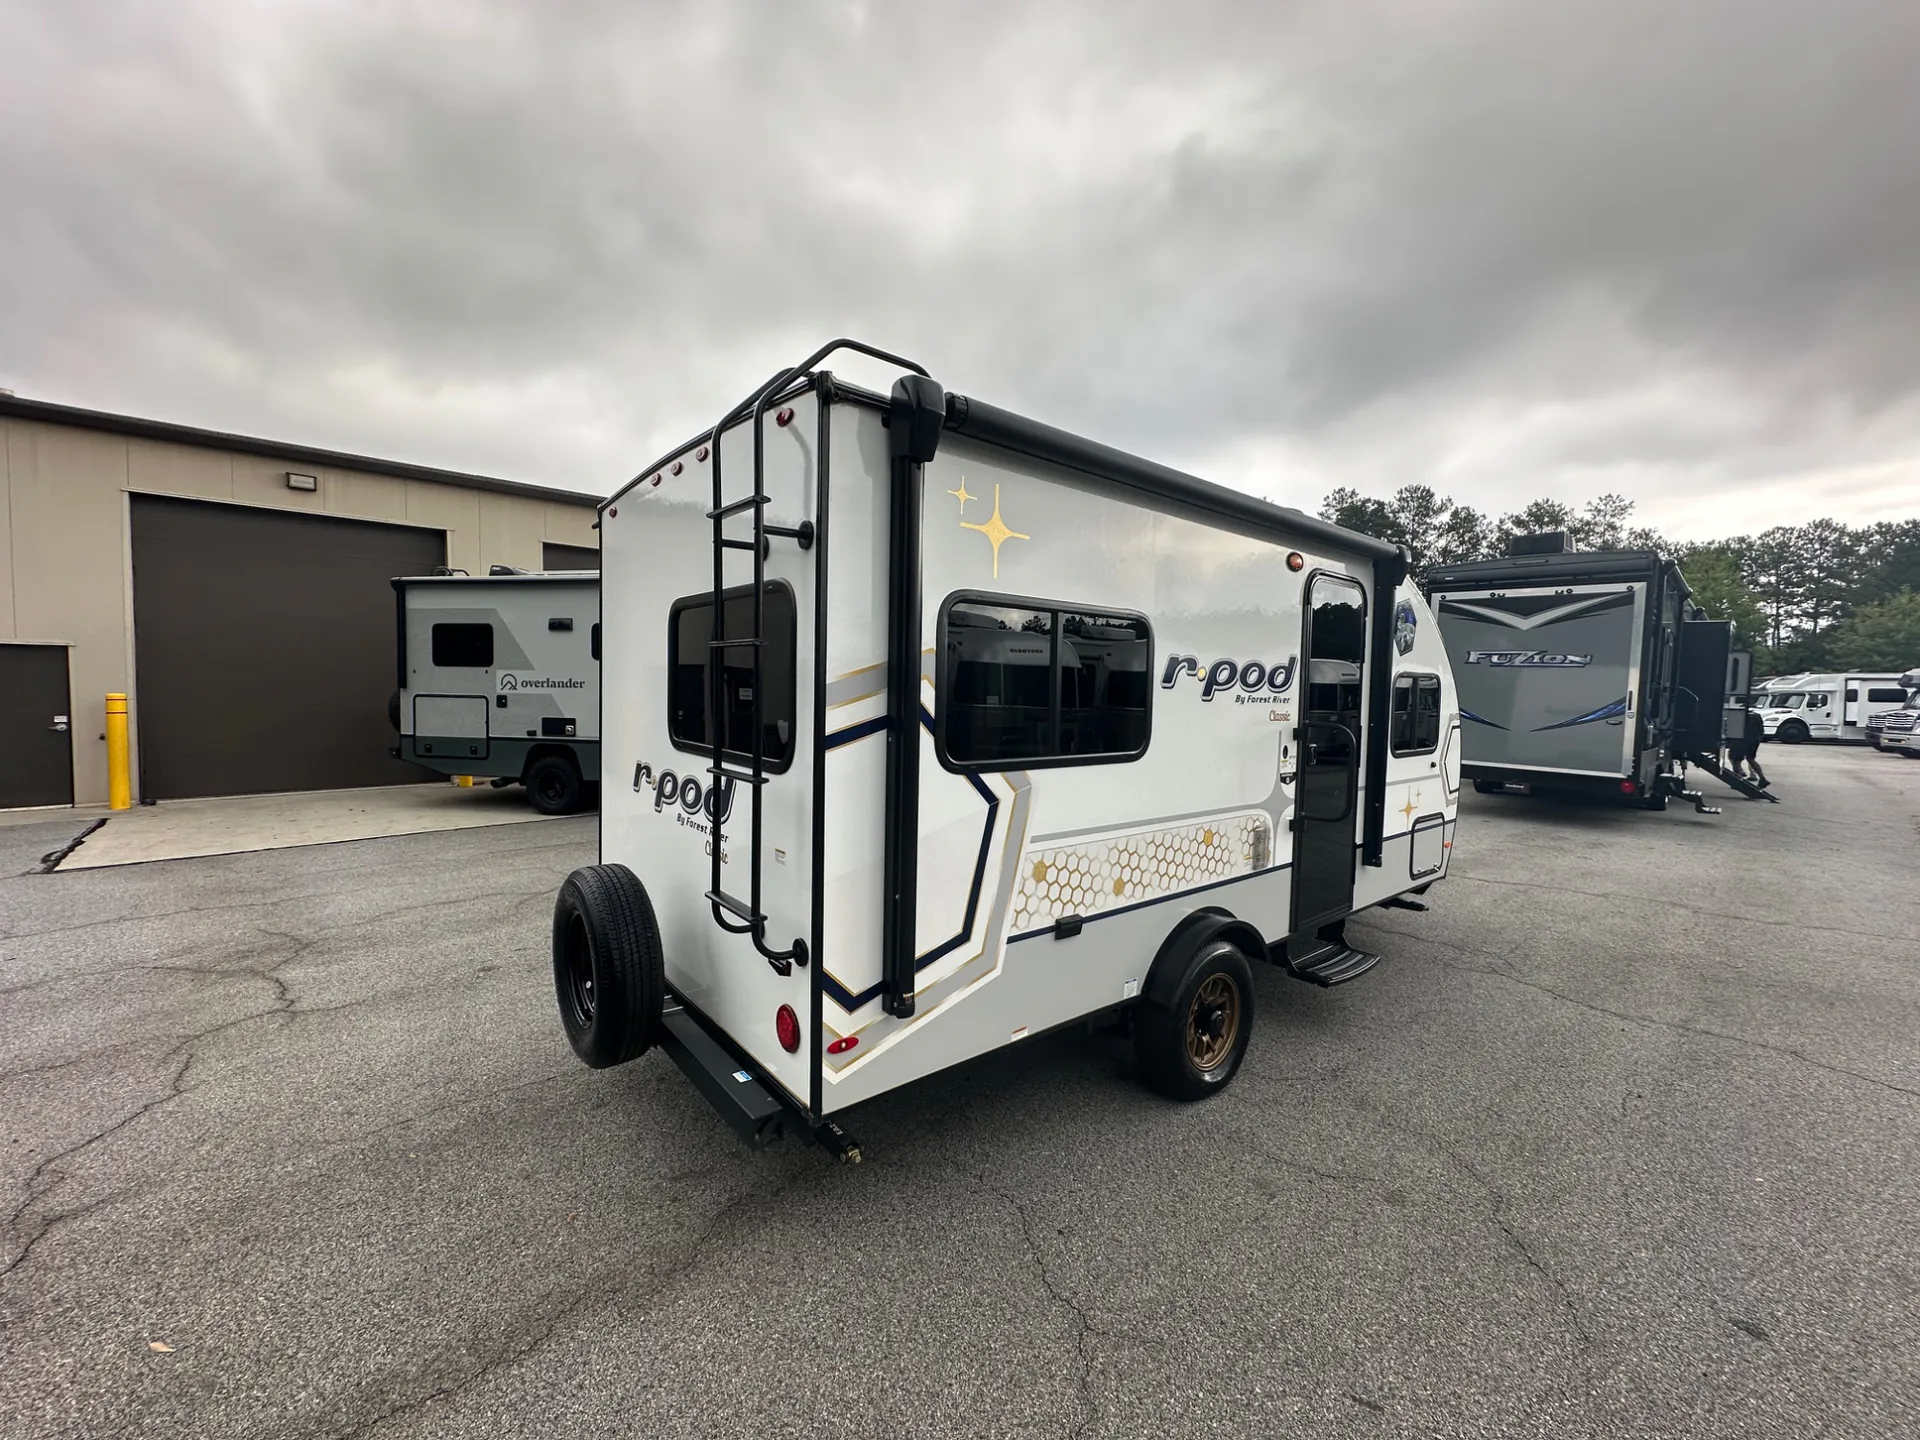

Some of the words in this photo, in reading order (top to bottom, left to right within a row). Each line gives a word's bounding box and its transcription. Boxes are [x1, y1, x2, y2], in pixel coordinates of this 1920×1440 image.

[1464, 650, 1593, 668] FUZION
[521, 678, 585, 688] overlander
[1235, 694, 1246, 705] By
[1247, 695, 1271, 704] Forest
[1272, 695, 1291, 704] River
[1268, 709, 1291, 721] Classic
[676, 812, 685, 826] By
[685, 816, 708, 835] Forest
[708, 826, 729, 843] Rer
